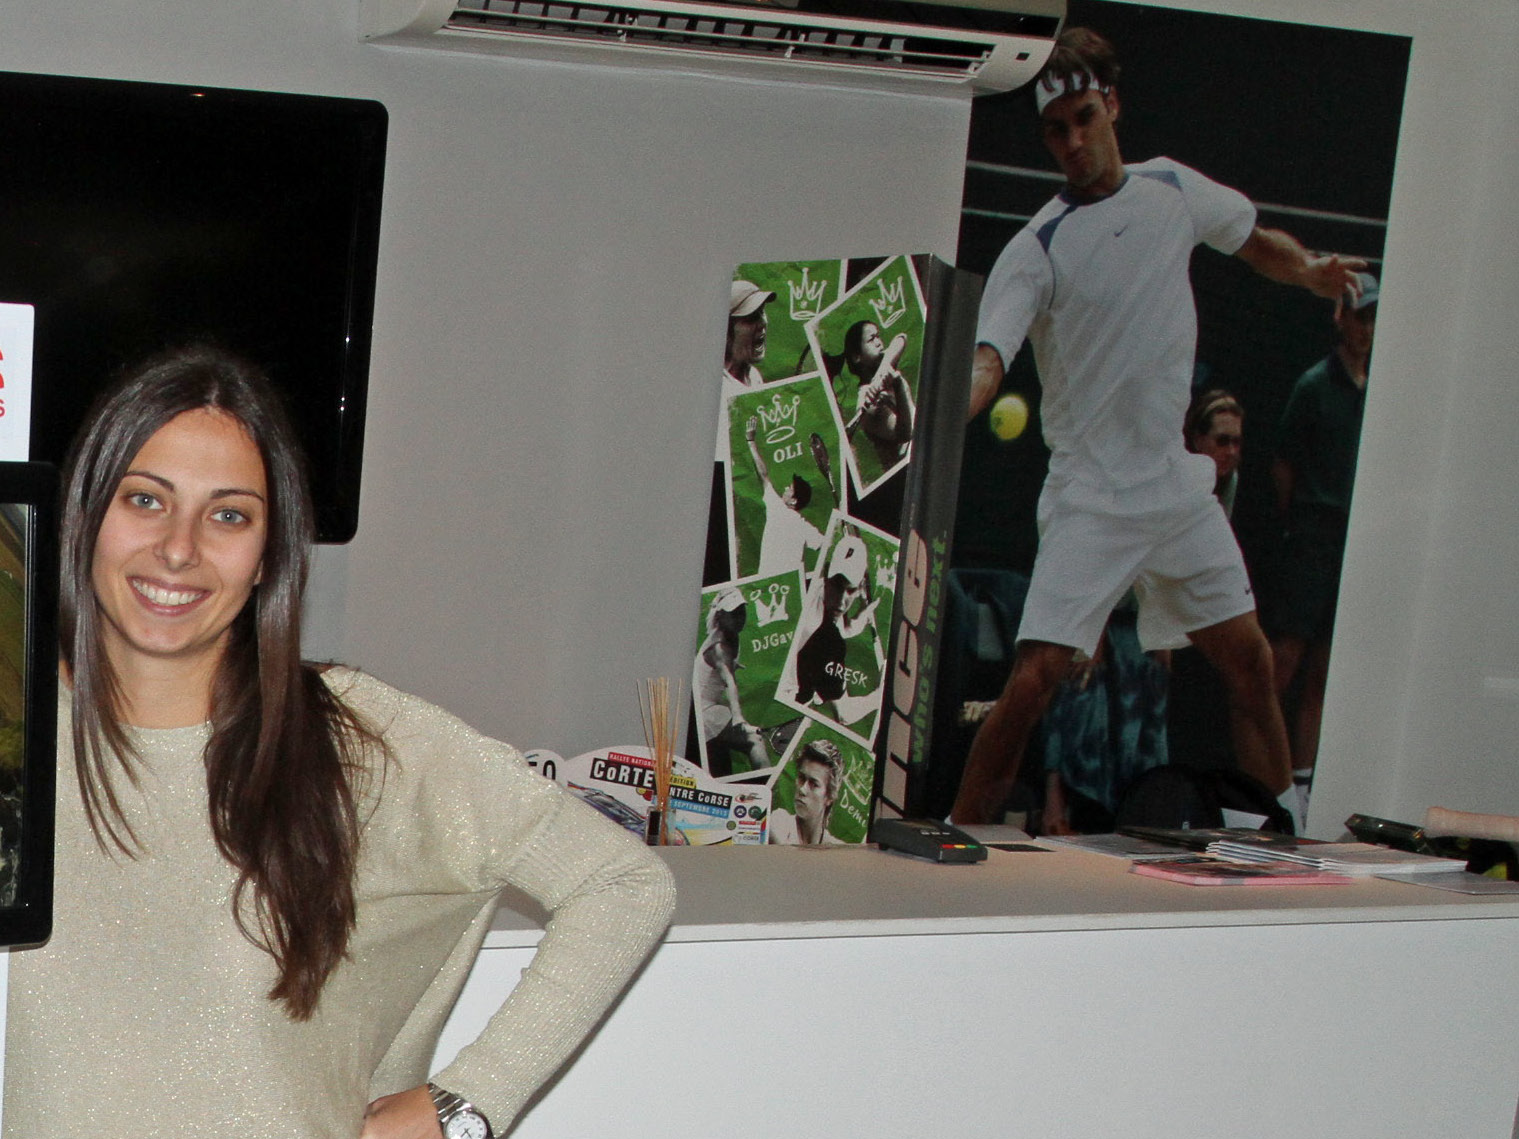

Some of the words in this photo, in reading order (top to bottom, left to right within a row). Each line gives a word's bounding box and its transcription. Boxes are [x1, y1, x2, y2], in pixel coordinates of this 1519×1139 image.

[773, 442, 804, 463] OLI
[925, 535, 946, 634] next
[751, 630, 795, 652] DJGav
[824, 661, 868, 688] GRESK
[669, 786, 695, 800] NTRE
